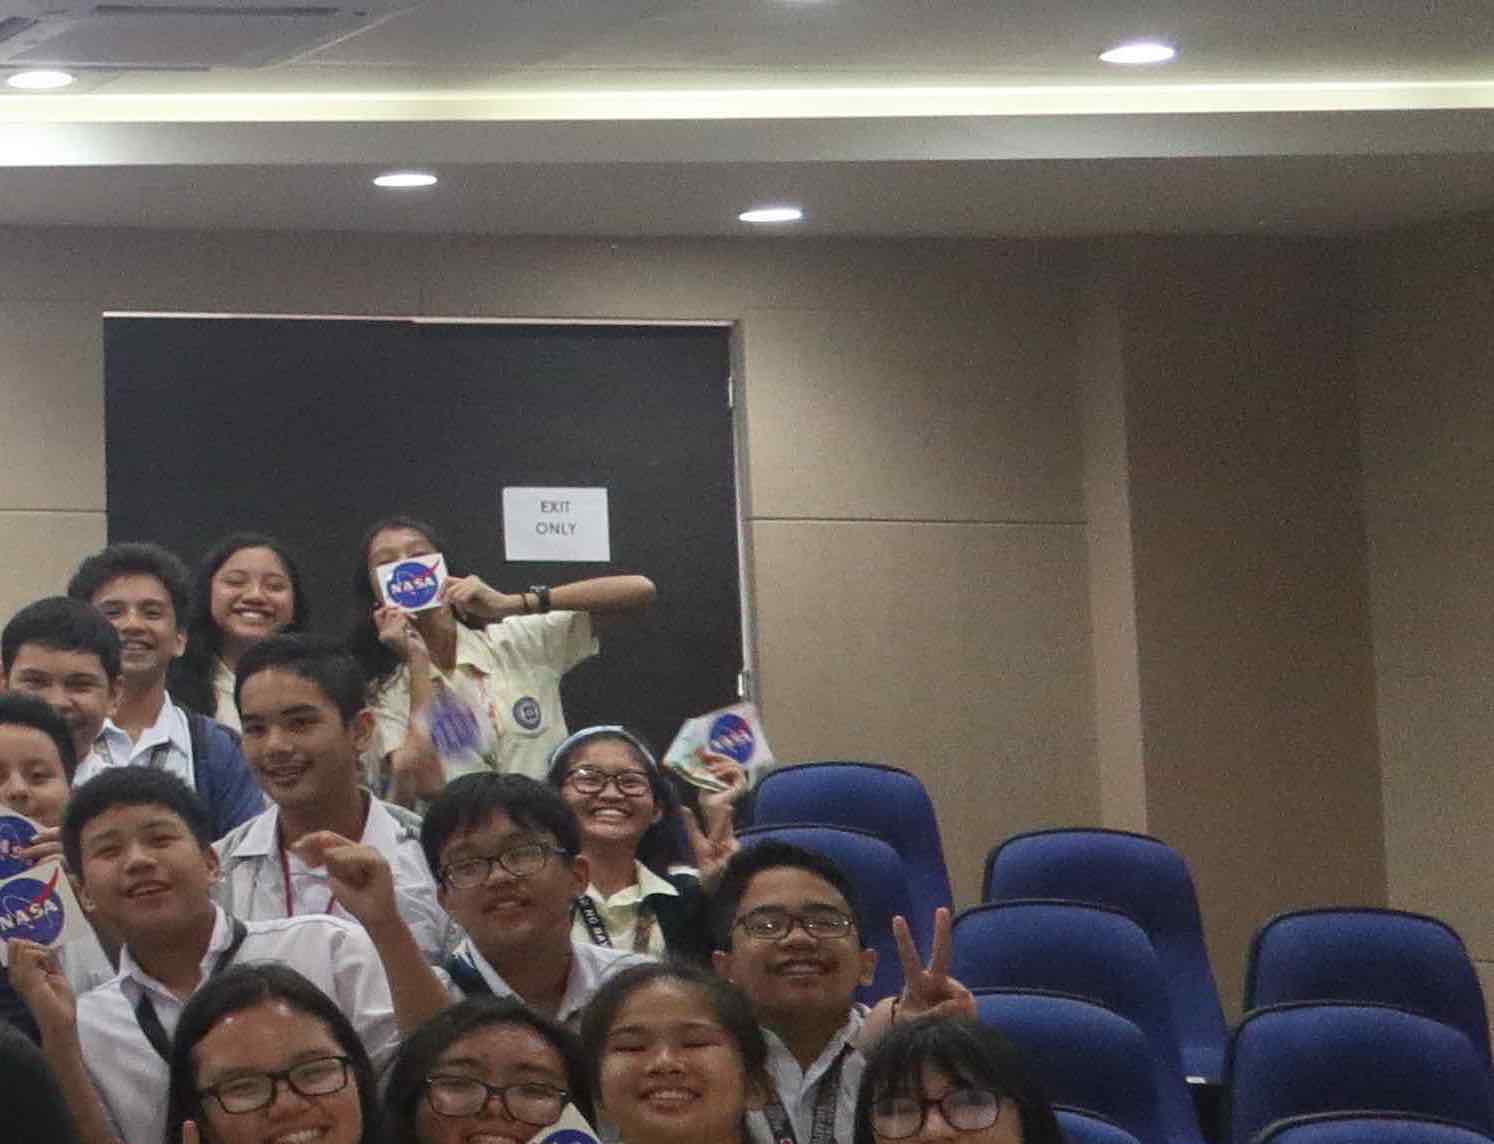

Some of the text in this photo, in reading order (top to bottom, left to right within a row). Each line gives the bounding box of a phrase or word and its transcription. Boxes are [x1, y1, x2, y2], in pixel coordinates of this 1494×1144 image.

[540, 500, 571, 513] EXIT
[535, 522, 577, 535] ONLY
[390, 576, 435, 593] NASA
